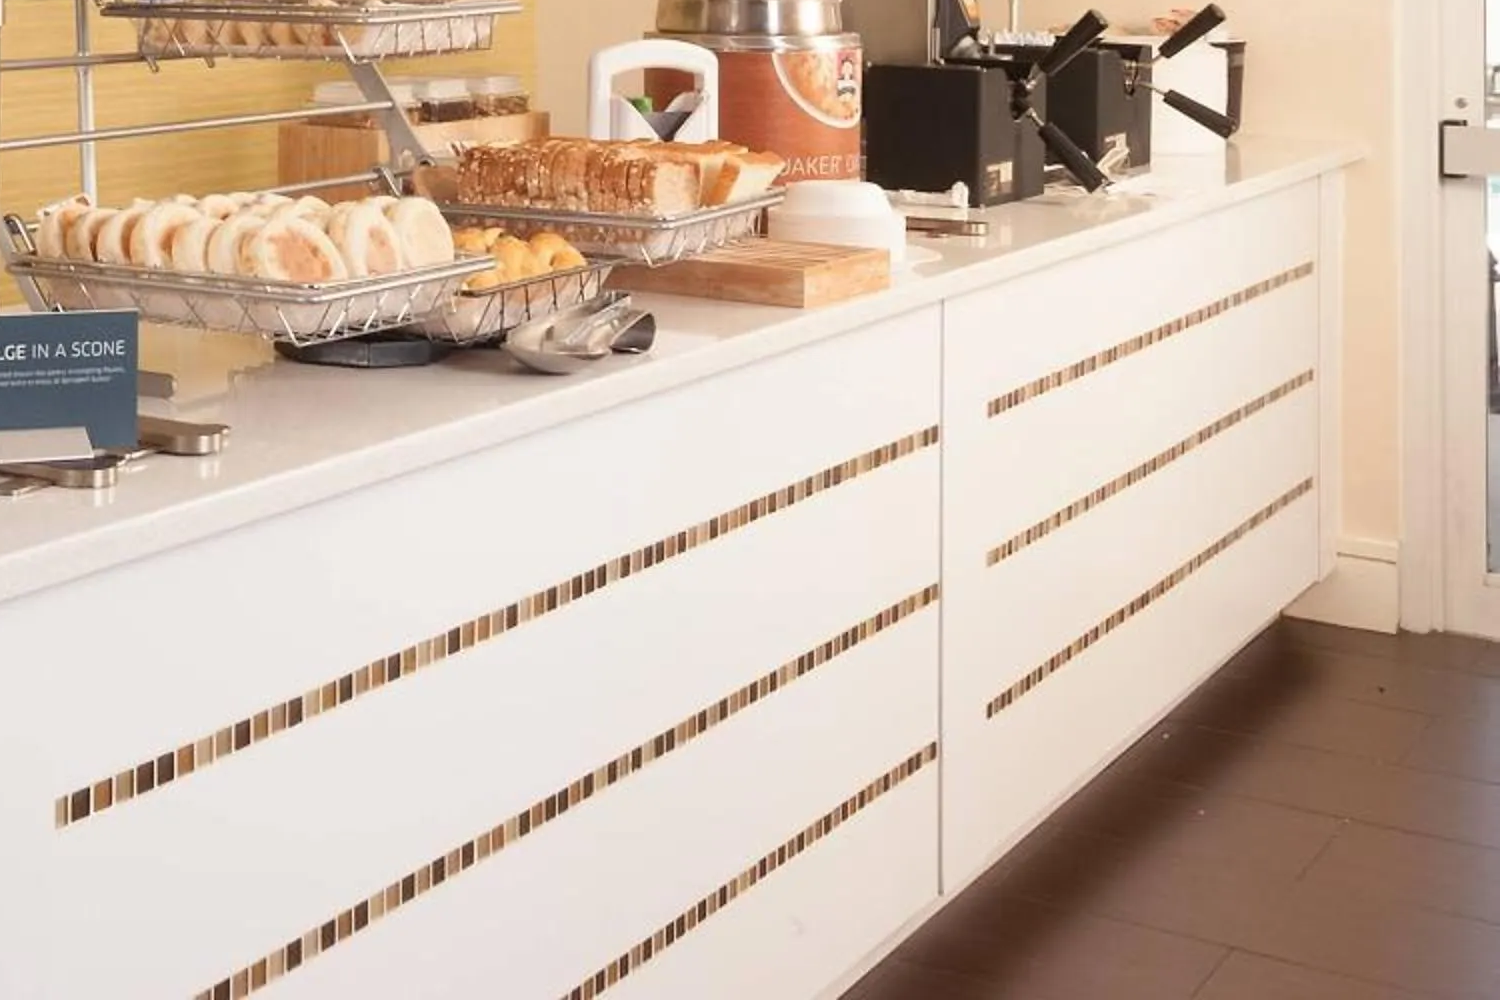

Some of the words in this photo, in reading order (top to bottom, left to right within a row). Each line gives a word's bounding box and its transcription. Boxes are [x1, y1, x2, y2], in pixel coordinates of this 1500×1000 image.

[781, 155, 842, 176] UAKER
[31, 343, 49, 359] IN
[55, 343, 67, 358] A
[71, 339, 126, 358] SCONE
